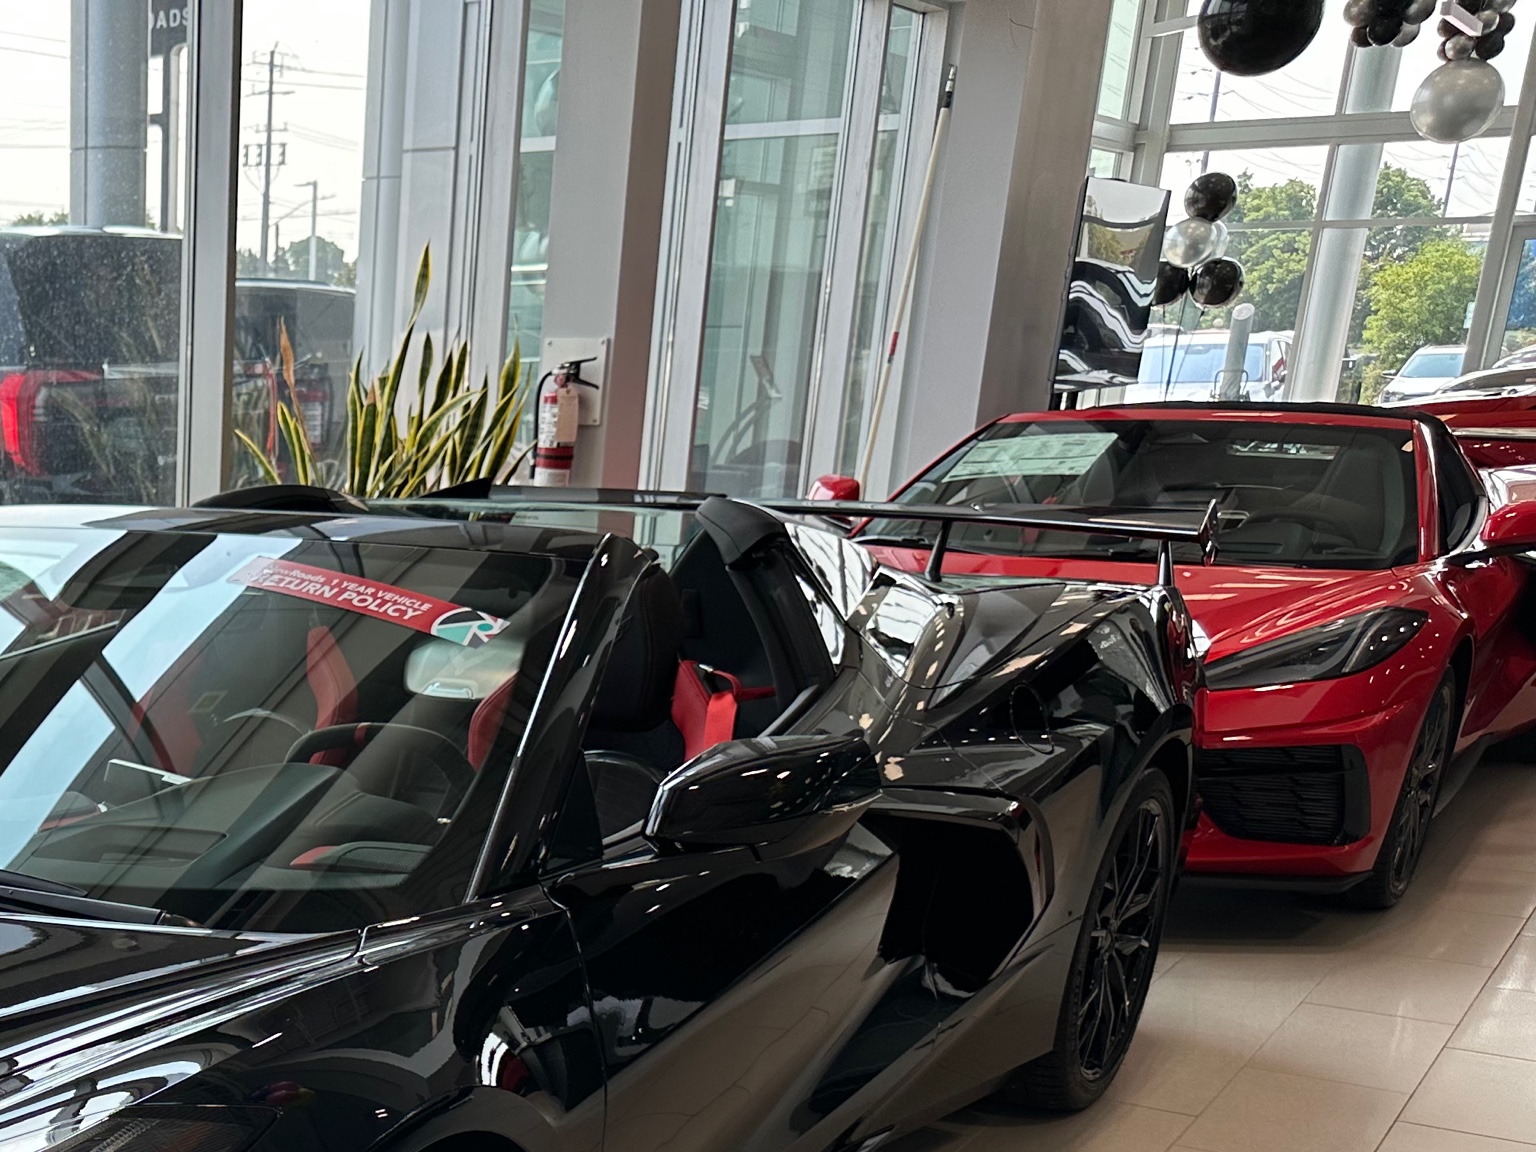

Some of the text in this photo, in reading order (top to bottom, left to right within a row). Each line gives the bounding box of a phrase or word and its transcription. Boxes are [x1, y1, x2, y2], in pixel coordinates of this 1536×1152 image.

[150, 8, 188, 28] ADS
[331, 578, 339, 586] 1
[341, 581, 376, 595] YEAR
[377, 590, 433, 611] VEHICLE
[337, 591, 423, 620] POLICY
